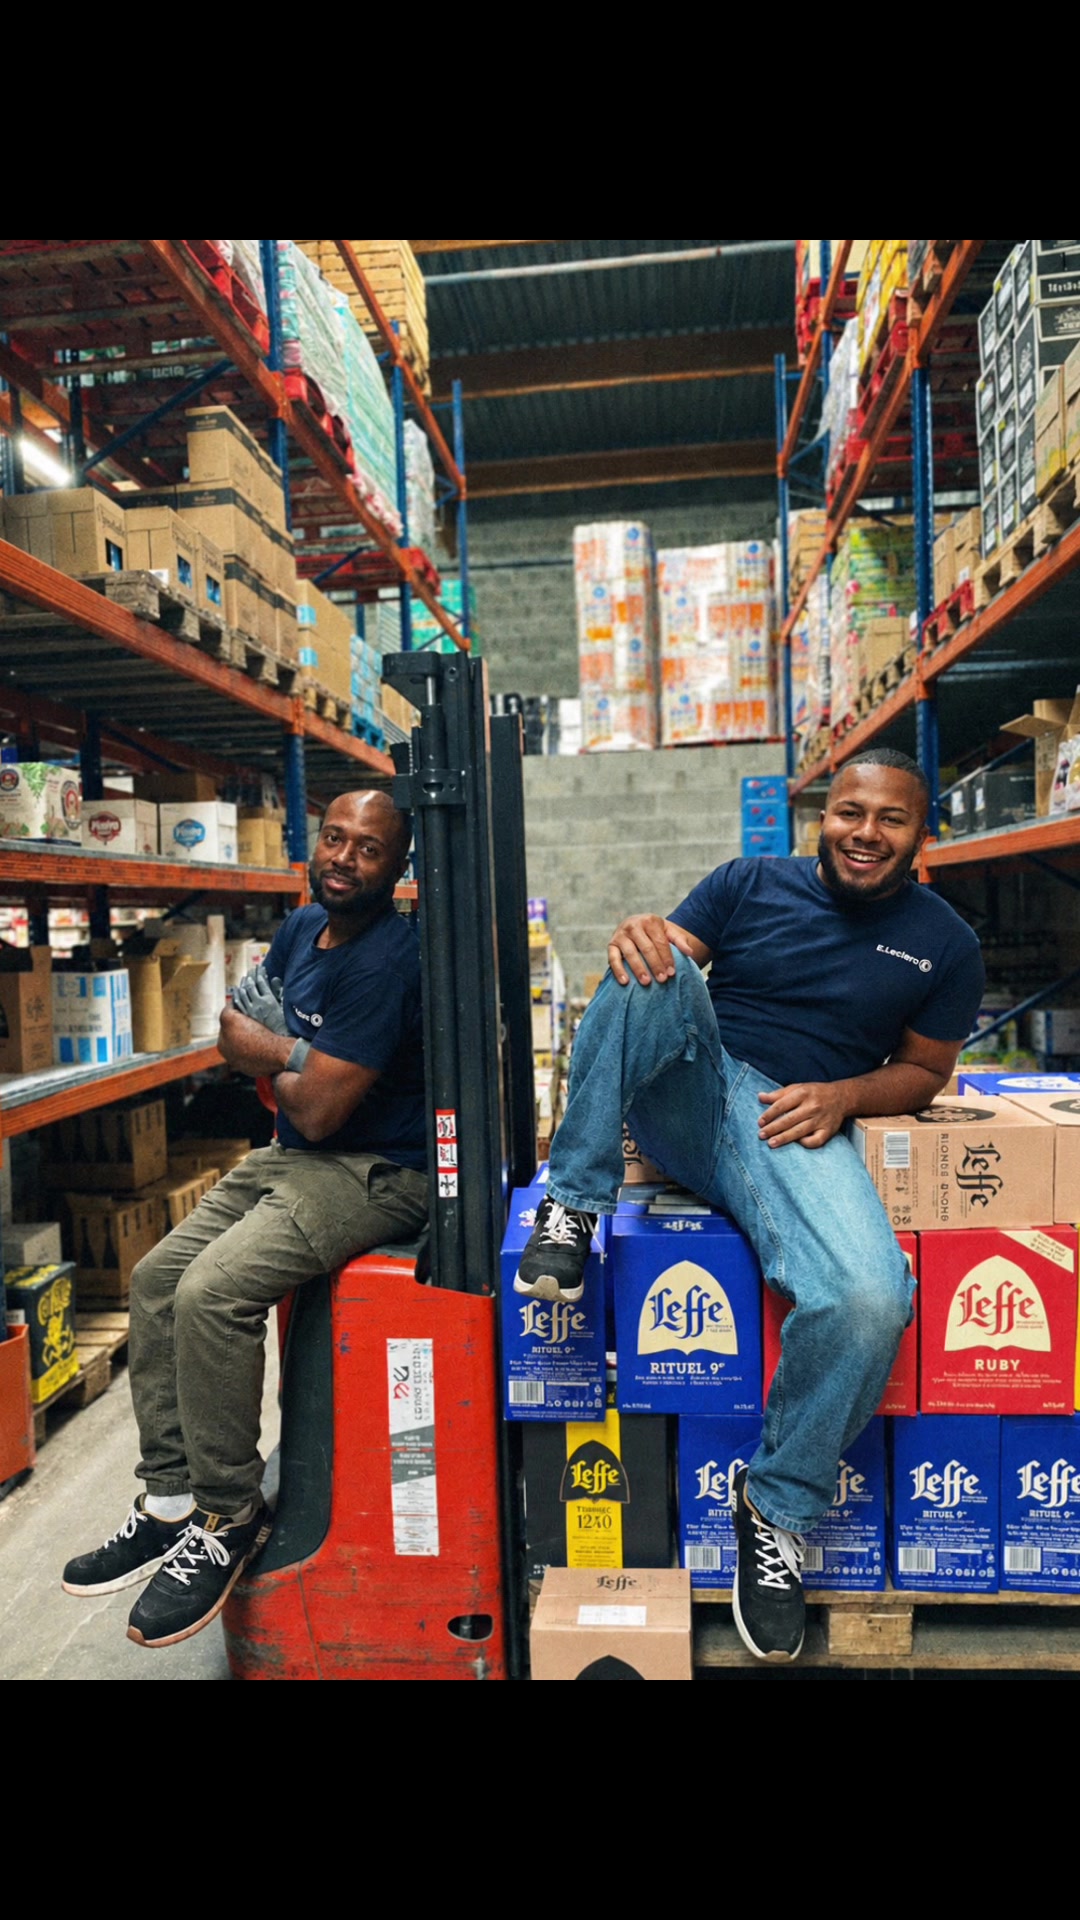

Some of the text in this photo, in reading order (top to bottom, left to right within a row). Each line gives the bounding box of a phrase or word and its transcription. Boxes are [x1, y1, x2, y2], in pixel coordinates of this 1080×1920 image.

[955, 1141, 1003, 1207] Leffe
[519, 1300, 587, 1343] Leffe
[648, 1285, 724, 1338] Leffe
[956, 1281, 1035, 1335] Leffe
[650, 1362, 706, 1374] RITUEL
[975, 1359, 1020, 1371] RUBY
[570, 1459, 619, 1494] Leffe
[909, 1460, 981, 1508] Leffe
